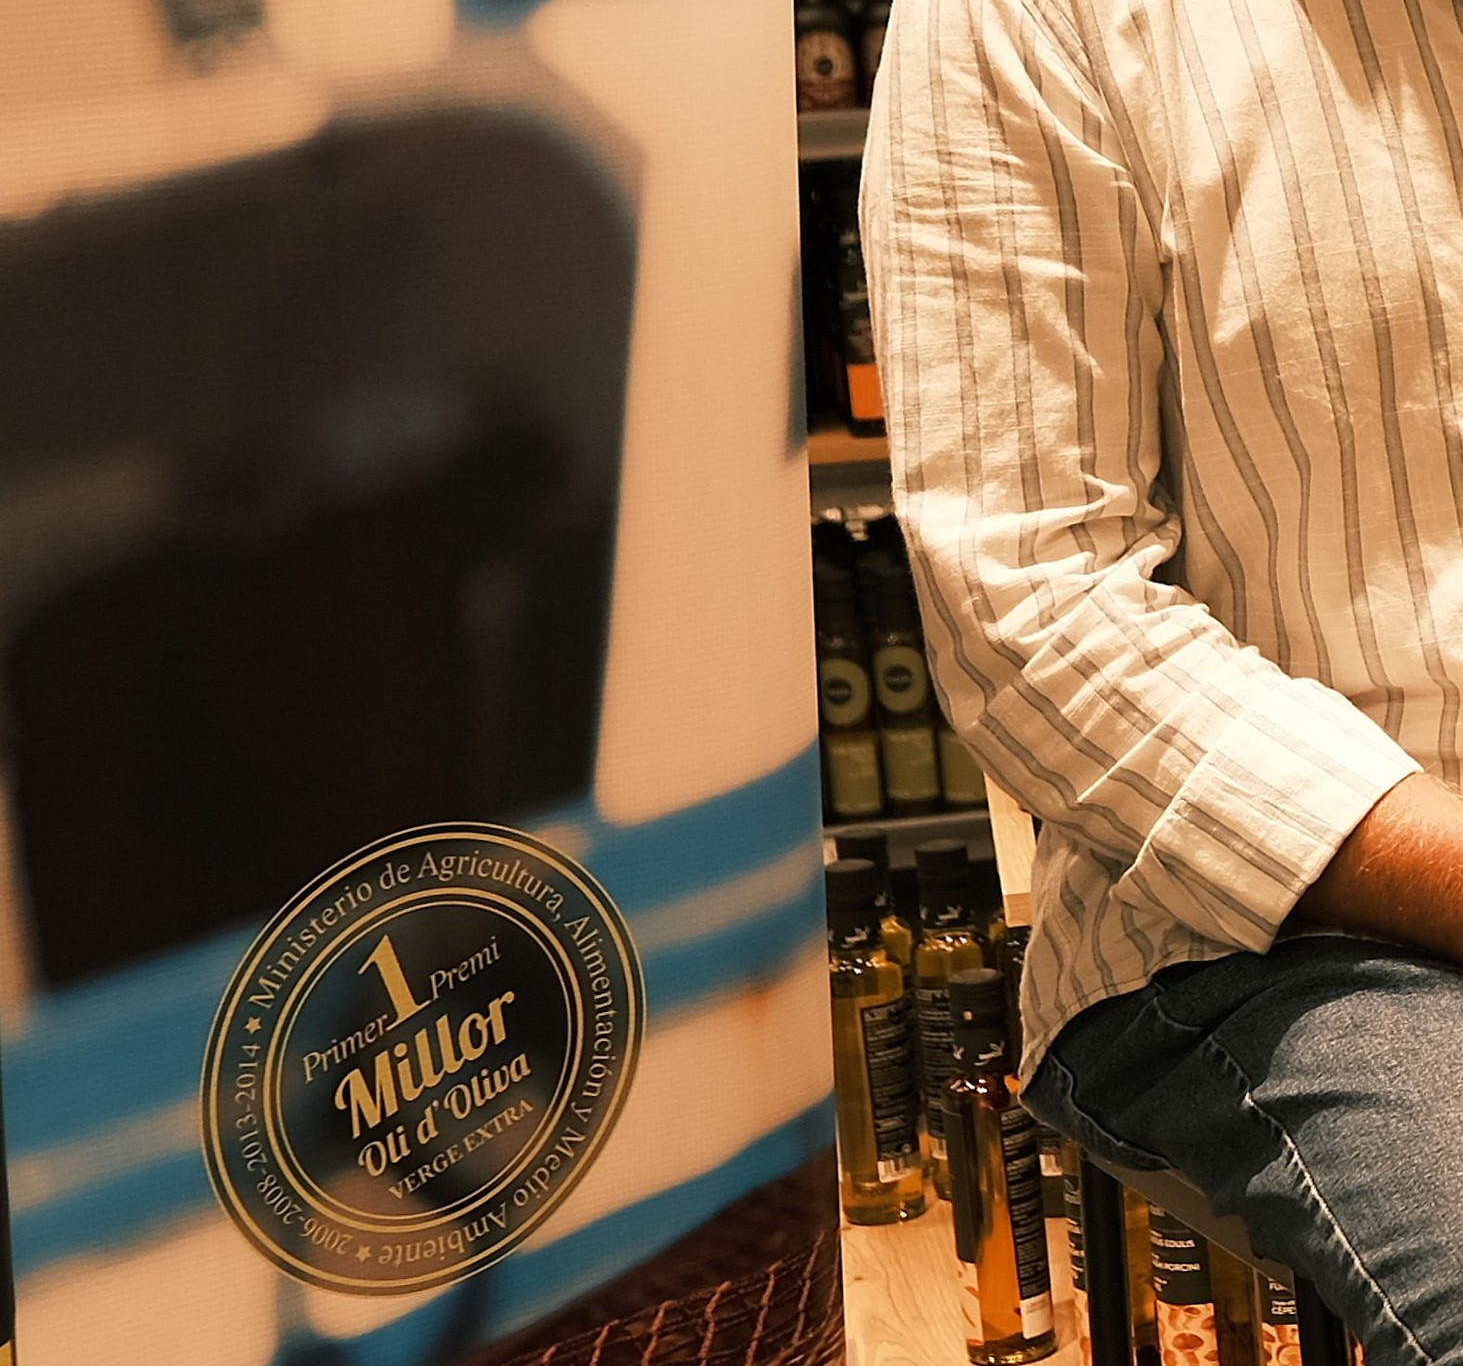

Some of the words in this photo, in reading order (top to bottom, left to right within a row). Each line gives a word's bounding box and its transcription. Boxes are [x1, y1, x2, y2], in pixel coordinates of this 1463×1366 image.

[378, 862, 412, 892] de
[417, 850, 566, 923] Agricultura,
[249, 882, 373, 1010] Ministerio
[356, 933, 432, 1032] 1
[301, 1012, 389, 1086] Primer
[428, 935, 502, 1002] Premi
[563, 912, 617, 1100] Alimentación
[333, 990, 516, 1141] Millor
[357, 1129, 411, 1178] Oli
[388, 1143, 464, 1201] VERGE
[465, 1097, 535, 1155] EXTRA
[570, 1100, 592, 1123] y
[511, 1127, 587, 1208] Medio
[377, 1201, 509, 1266] Ambiente
